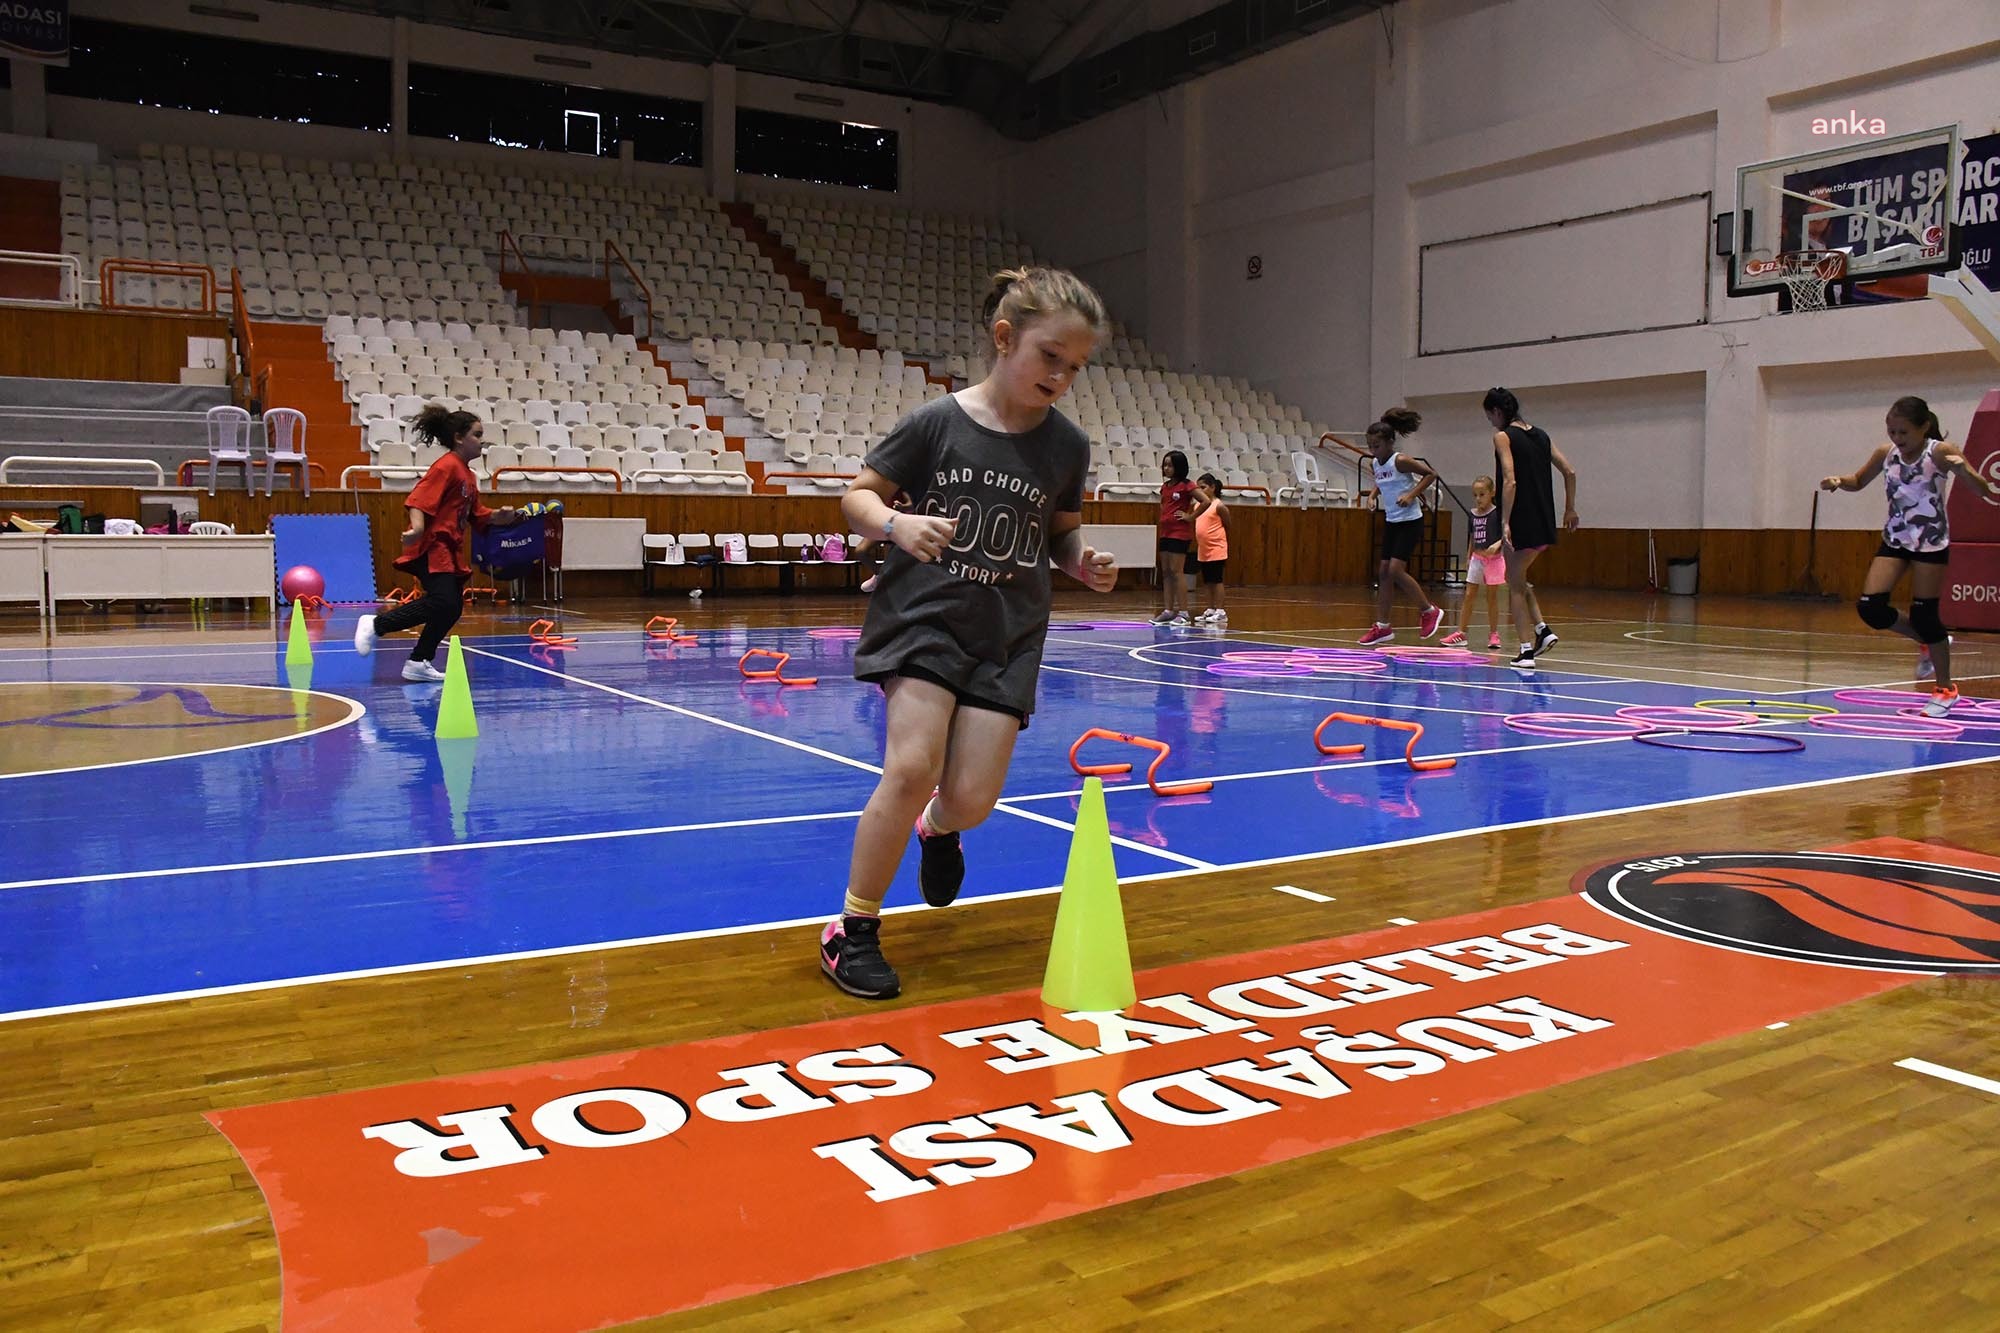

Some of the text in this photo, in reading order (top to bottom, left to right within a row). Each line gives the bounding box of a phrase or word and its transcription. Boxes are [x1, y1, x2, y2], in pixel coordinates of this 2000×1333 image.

[0, 2, 62, 25] ADASI
[935, 467, 1048, 509] BAD CHOICE
[948, 559, 1000, 585] STORY
[1623, 855, 1700, 873] 2015
[362, 922, 1631, 1179] BELEDİYE SPOR
[811, 994, 1616, 1203] KUŞADASI
